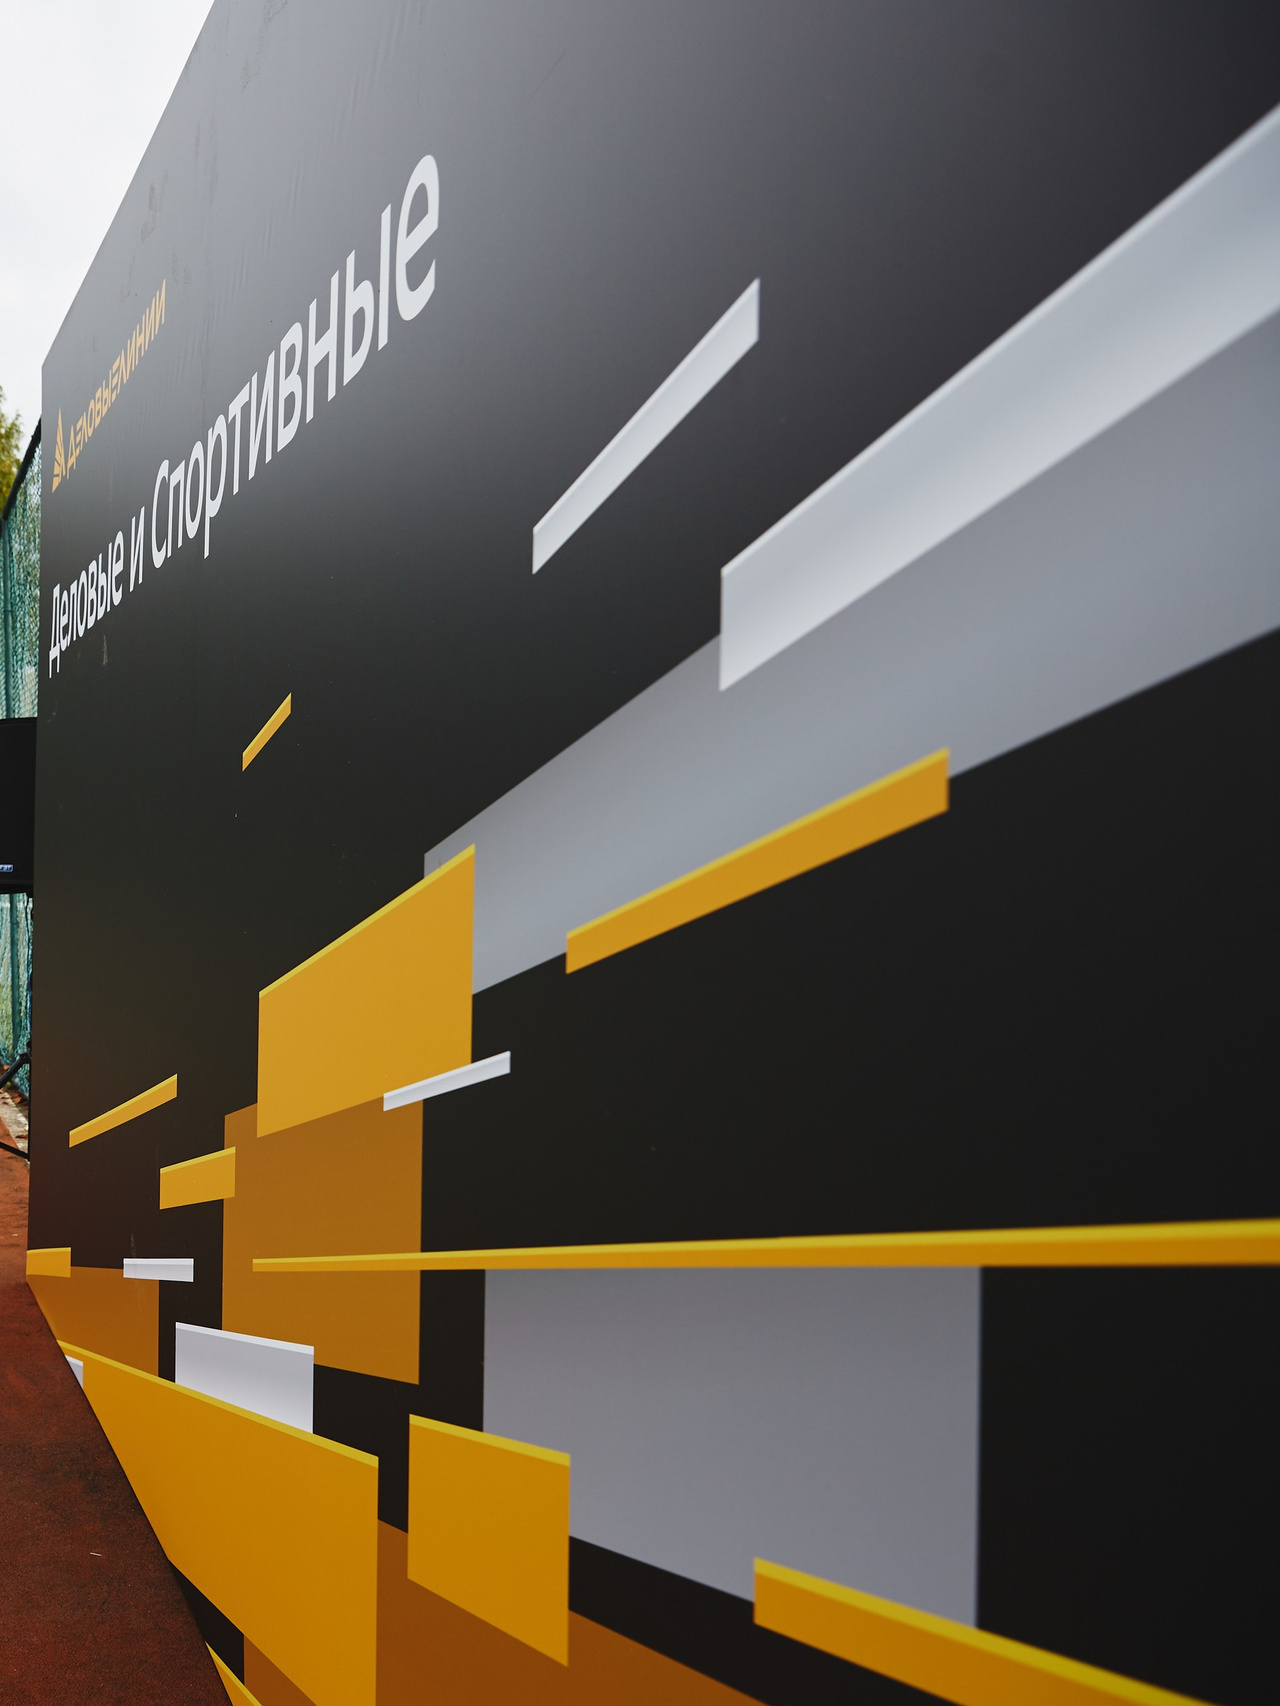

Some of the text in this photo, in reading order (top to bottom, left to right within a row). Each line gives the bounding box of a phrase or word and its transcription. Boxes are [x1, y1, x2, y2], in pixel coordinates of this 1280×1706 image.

[49, 154, 440, 679] Деловые и Спортивные
[67, 279, 166, 480] ДЕЛОВЫЕЛИНИИ
